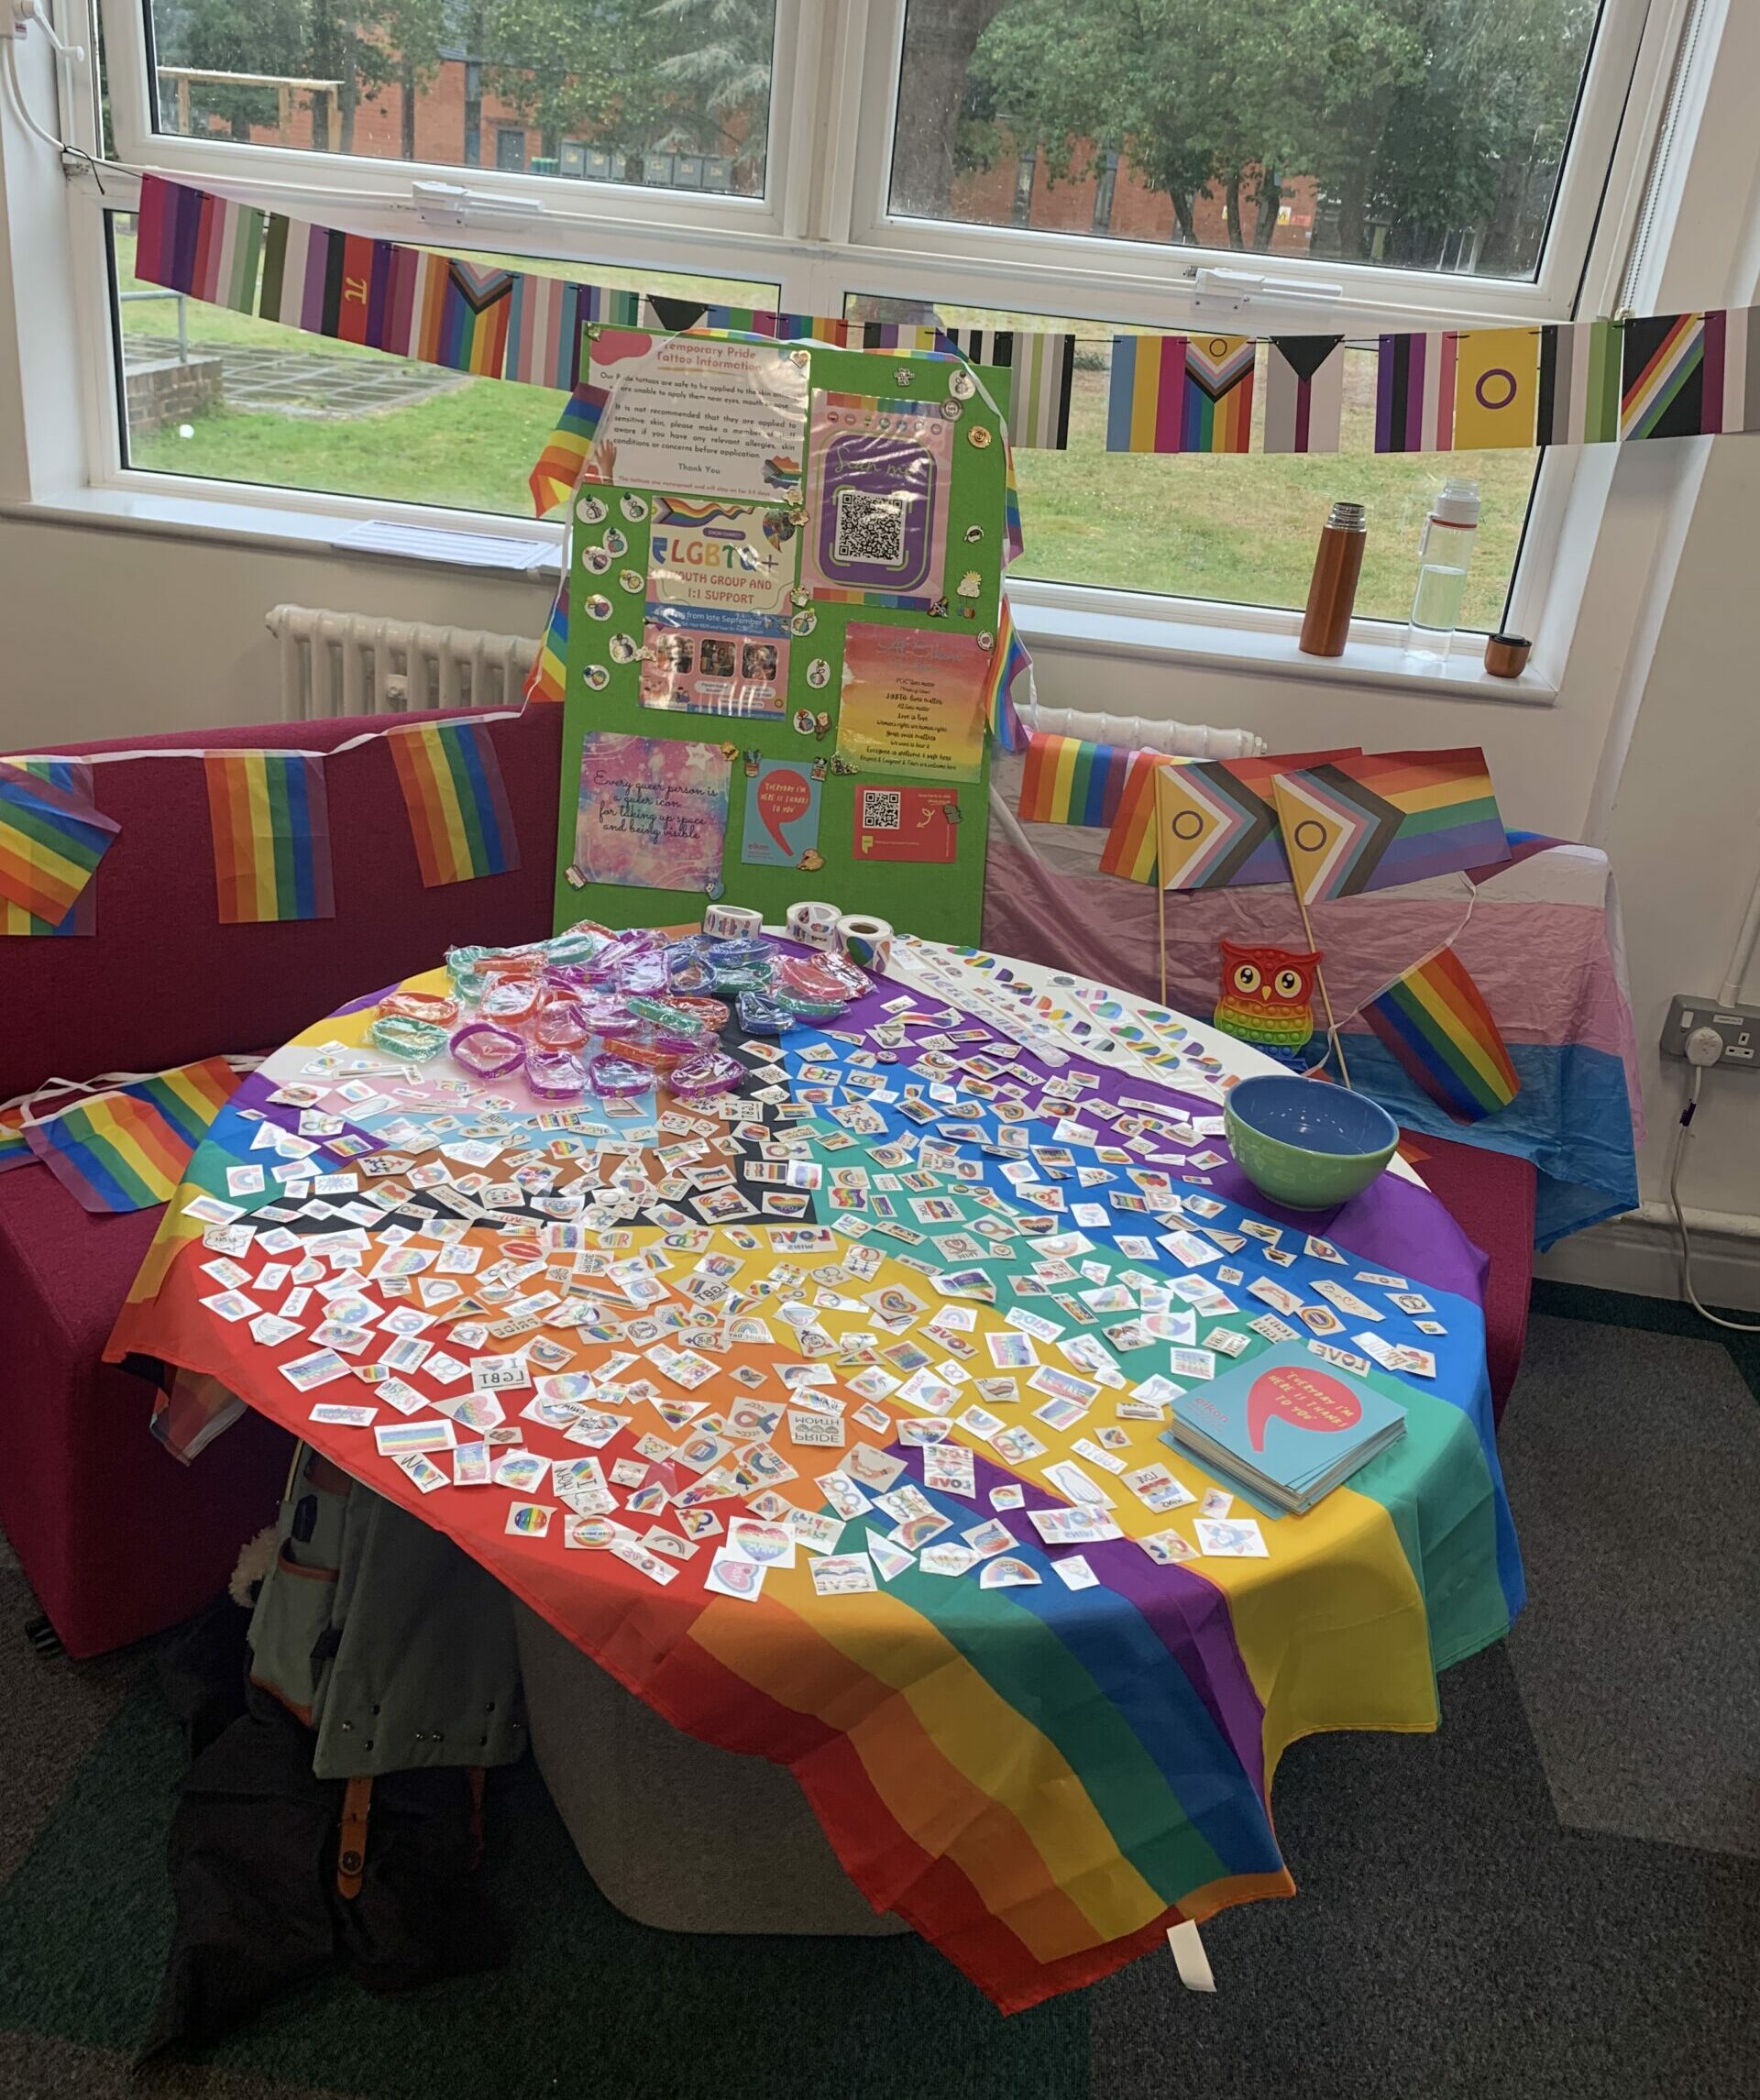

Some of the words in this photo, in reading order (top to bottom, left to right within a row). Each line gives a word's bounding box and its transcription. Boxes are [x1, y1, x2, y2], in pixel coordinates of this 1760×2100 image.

[663, 342, 724, 358] Temporary
[726, 346, 757, 359] Pride
[656, 351, 692, 365] Tattoo
[696, 355, 763, 371] Information
[600, 371, 614, 379] Our
[635, 377, 660, 385] tattoos
[674, 379, 688, 388] safe
[699, 383, 710, 391] be
[710, 384, 735, 395] applied
[633, 387, 657, 396] unable
[667, 391, 687, 401] apply
[688, 392, 706, 401] them
[614, 414, 645, 424] sensitive
[670, 421, 694, 430] please
[698, 423, 718, 433] make
[732, 428, 762, 436] member
[615, 403, 621, 412] It
[649, 408, 701, 420] recommended
[704, 412, 720, 422] that
[722, 415, 740, 424] they
[757, 418, 786, 429] applied
[612, 436, 650, 447] conditions
[661, 443, 693, 453] concerns
[694, 445, 719, 456] before
[652, 432, 666, 440] you
[670, 432, 688, 440] have
[692, 435, 706, 444] any
[710, 436, 741, 446] relevant
[781, 443, 796, 451] skin
[677, 462, 702, 473] Thank
[705, 465, 721, 475] You
[835, 445, 881, 474] Scan
[671, 539, 779, 573] LGBTQ+
[710, 575, 747, 588] GROUP
[749, 578, 773, 590] AND
[705, 589, 755, 605] SUPPORT
[687, 611, 705, 621] from
[706, 613, 720, 623] late
[721, 615, 763, 627] September
[594, 769, 633, 795] Every
[635, 782, 667, 797] queer
[666, 786, 705, 800] person
[707, 786, 719, 797] is
[623, 796, 654, 808] queer
[760, 792, 775, 801] HERE
[599, 800, 618, 823] for
[620, 806, 658, 824] taking
[659, 815, 675, 830] up
[676, 816, 707, 830] space
[772, 805, 781, 813] TO
[602, 818, 627, 832] and
[629, 819, 661, 844] being
[663, 825, 701, 840] visible
[1267, 1374, 1295, 1392] HERE
[1293, 1392, 1307, 1401] IS
[1306, 1401, 1349, 1428] THANKS
[1275, 1394, 1292, 1406] TO
[1194, 1397, 1230, 1423] eikon
[1335, 1404, 1355, 1418] I'M
